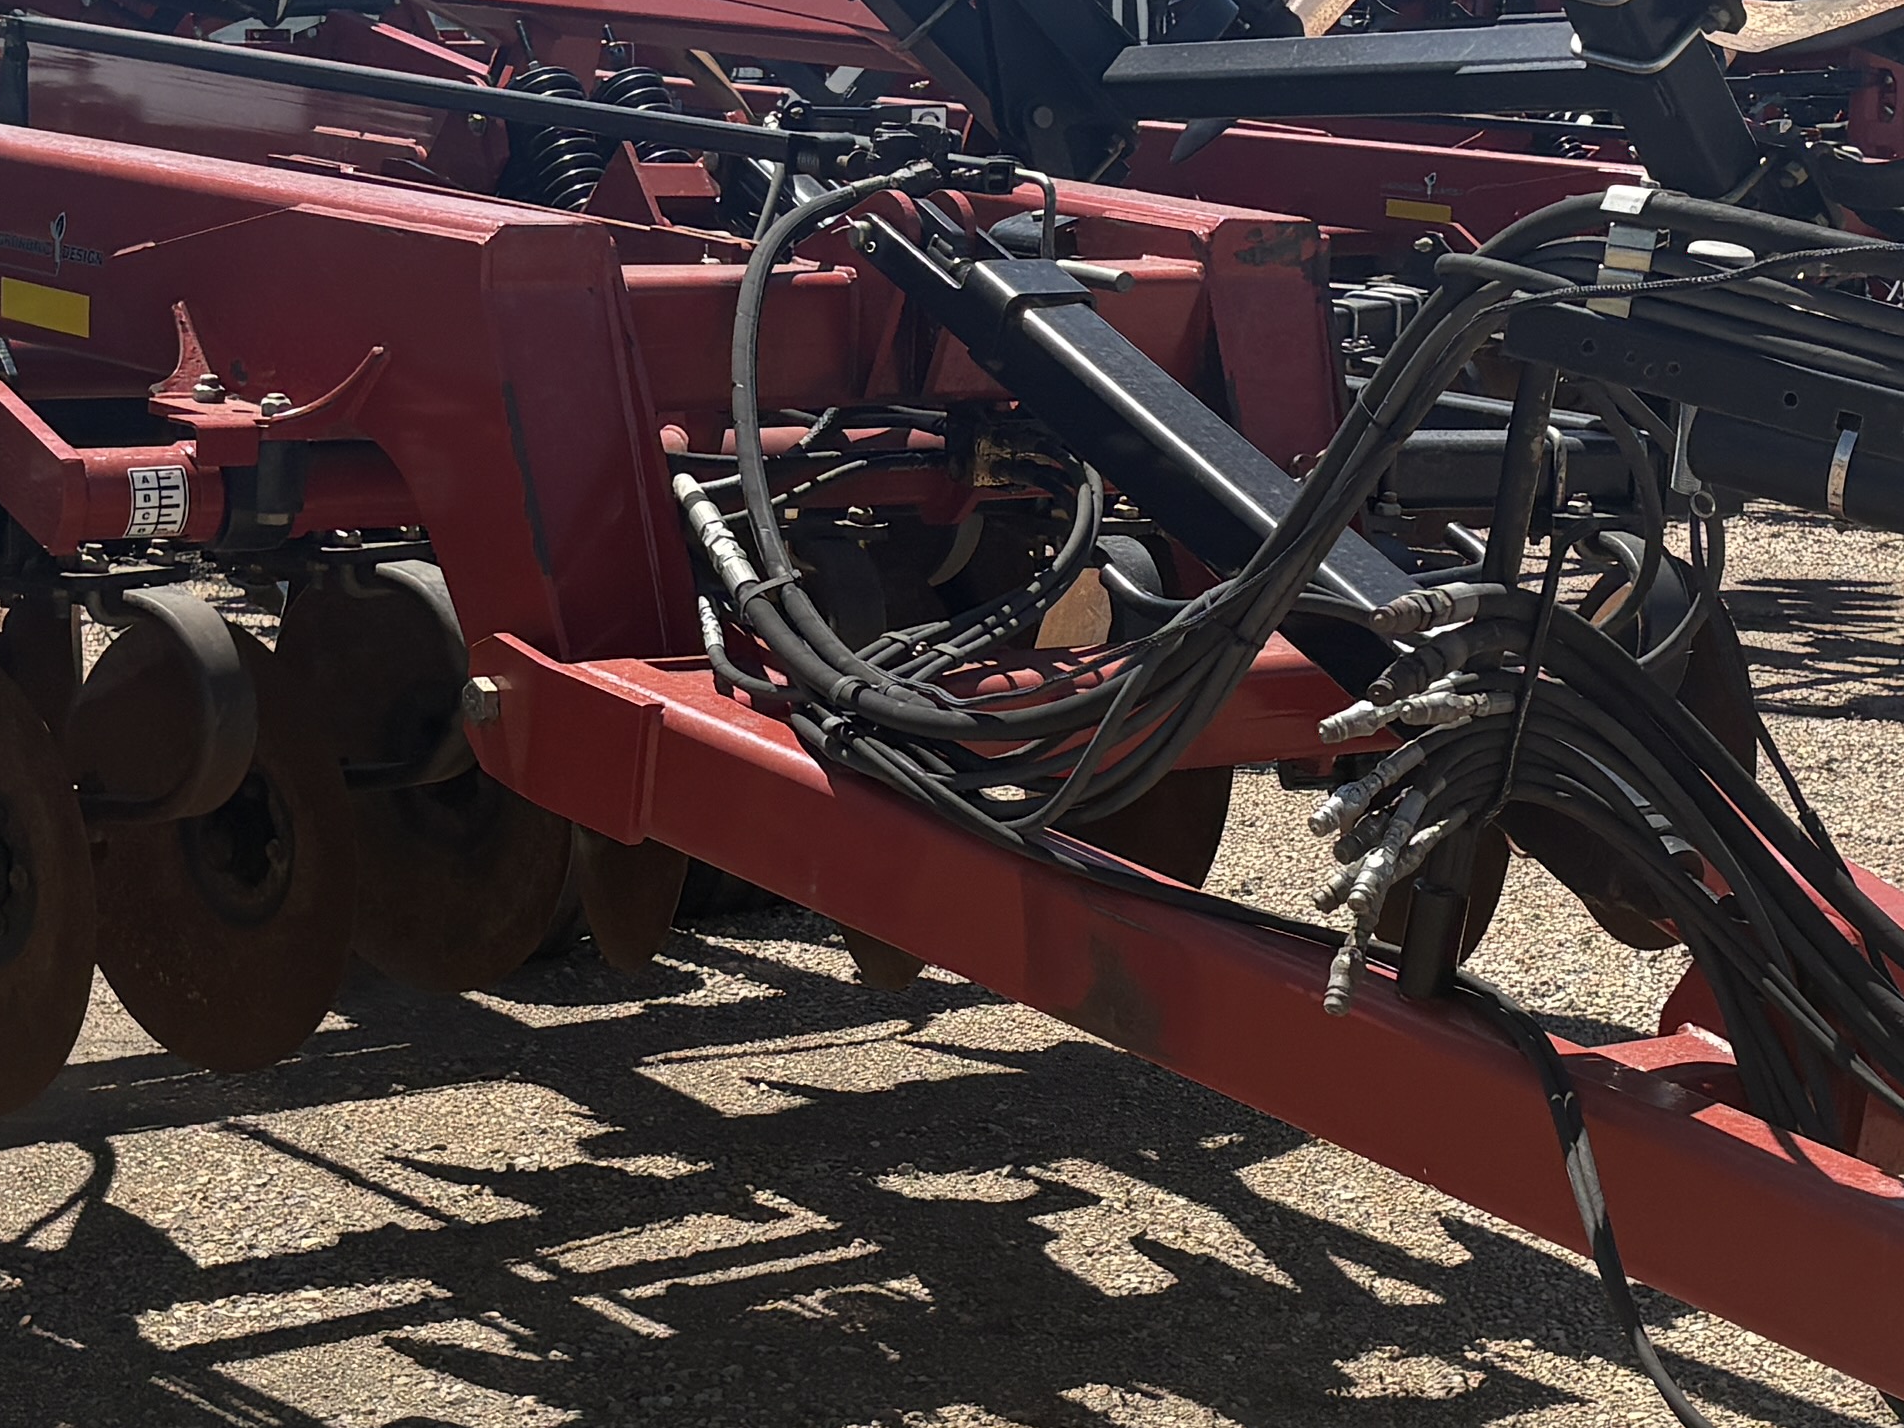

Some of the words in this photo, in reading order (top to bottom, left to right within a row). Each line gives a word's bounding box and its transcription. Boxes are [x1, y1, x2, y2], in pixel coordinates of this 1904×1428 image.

[62, 244, 104, 265] DESIGN
[141, 475, 150, 484] A
[141, 512, 151, 521] C
